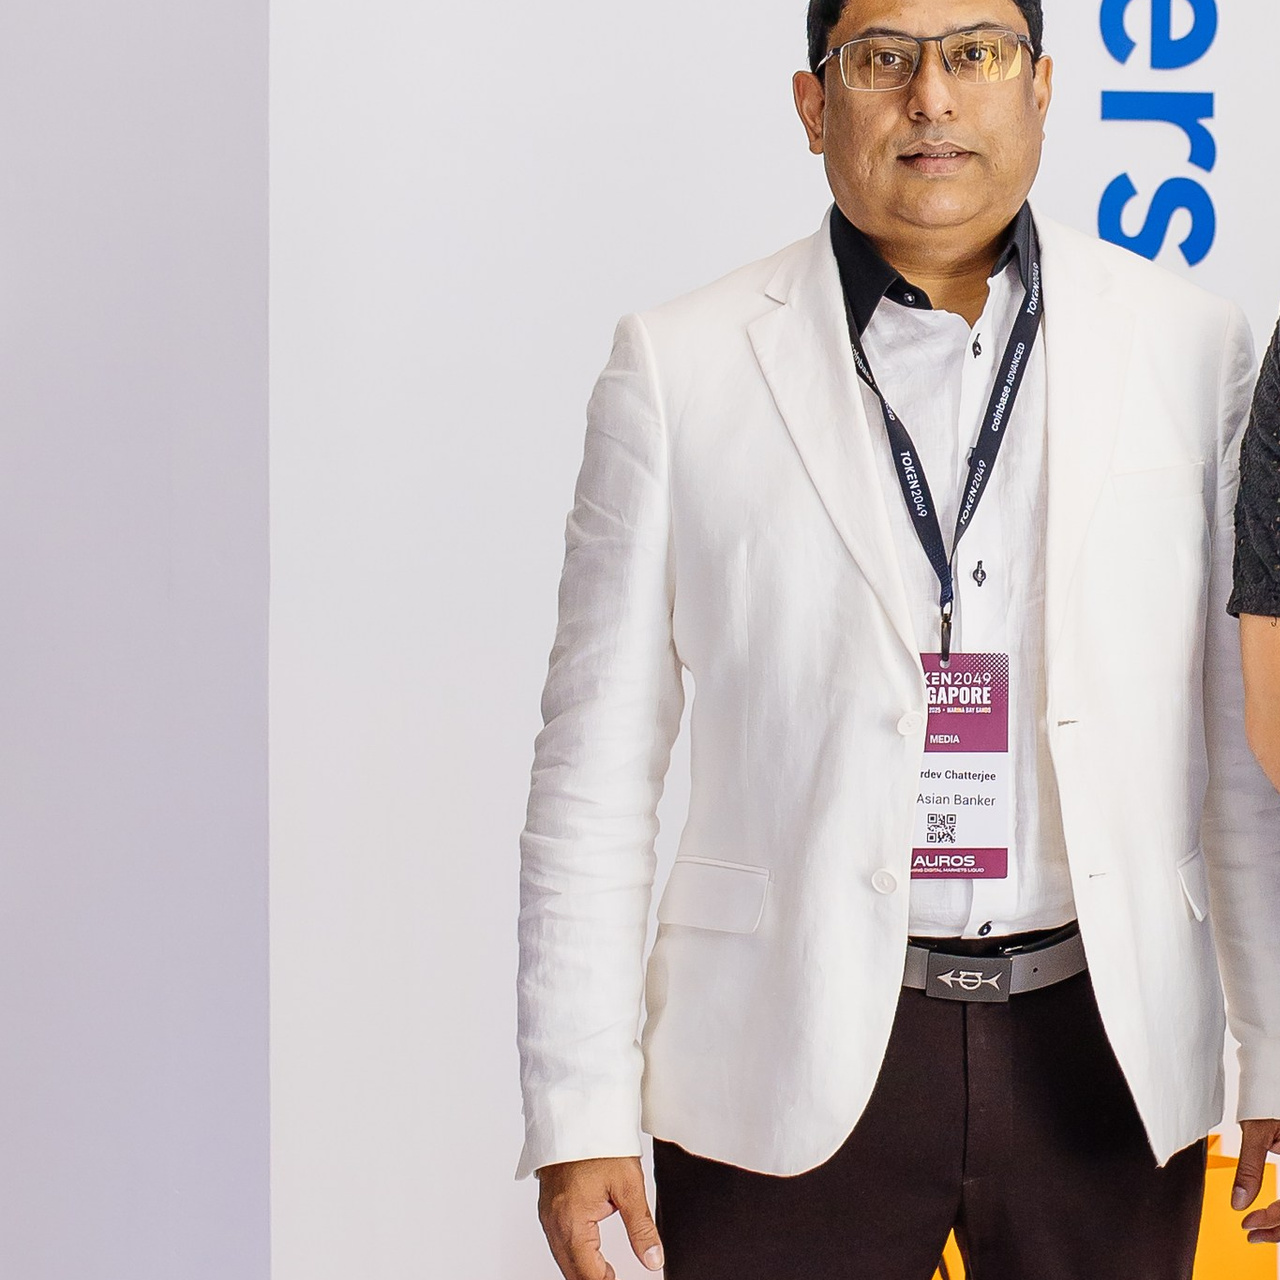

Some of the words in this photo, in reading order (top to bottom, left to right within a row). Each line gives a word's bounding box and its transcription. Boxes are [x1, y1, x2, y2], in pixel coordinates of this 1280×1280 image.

[990, 386, 1012, 432] coinbase
[1008, 341, 1026, 387] ADVANCED
[900, 450, 928, 518] TOKEN2049
[959, 459, 988, 526] TOKEN2049
[929, 734, 960, 744] MEDIA
[920, 769, 942, 780] rdev
[944, 770, 996, 782] Chatterjee
[916, 793, 950, 805] Asian
[954, 794, 996, 807] Banker
[913, 856, 975, 867] AUROS
